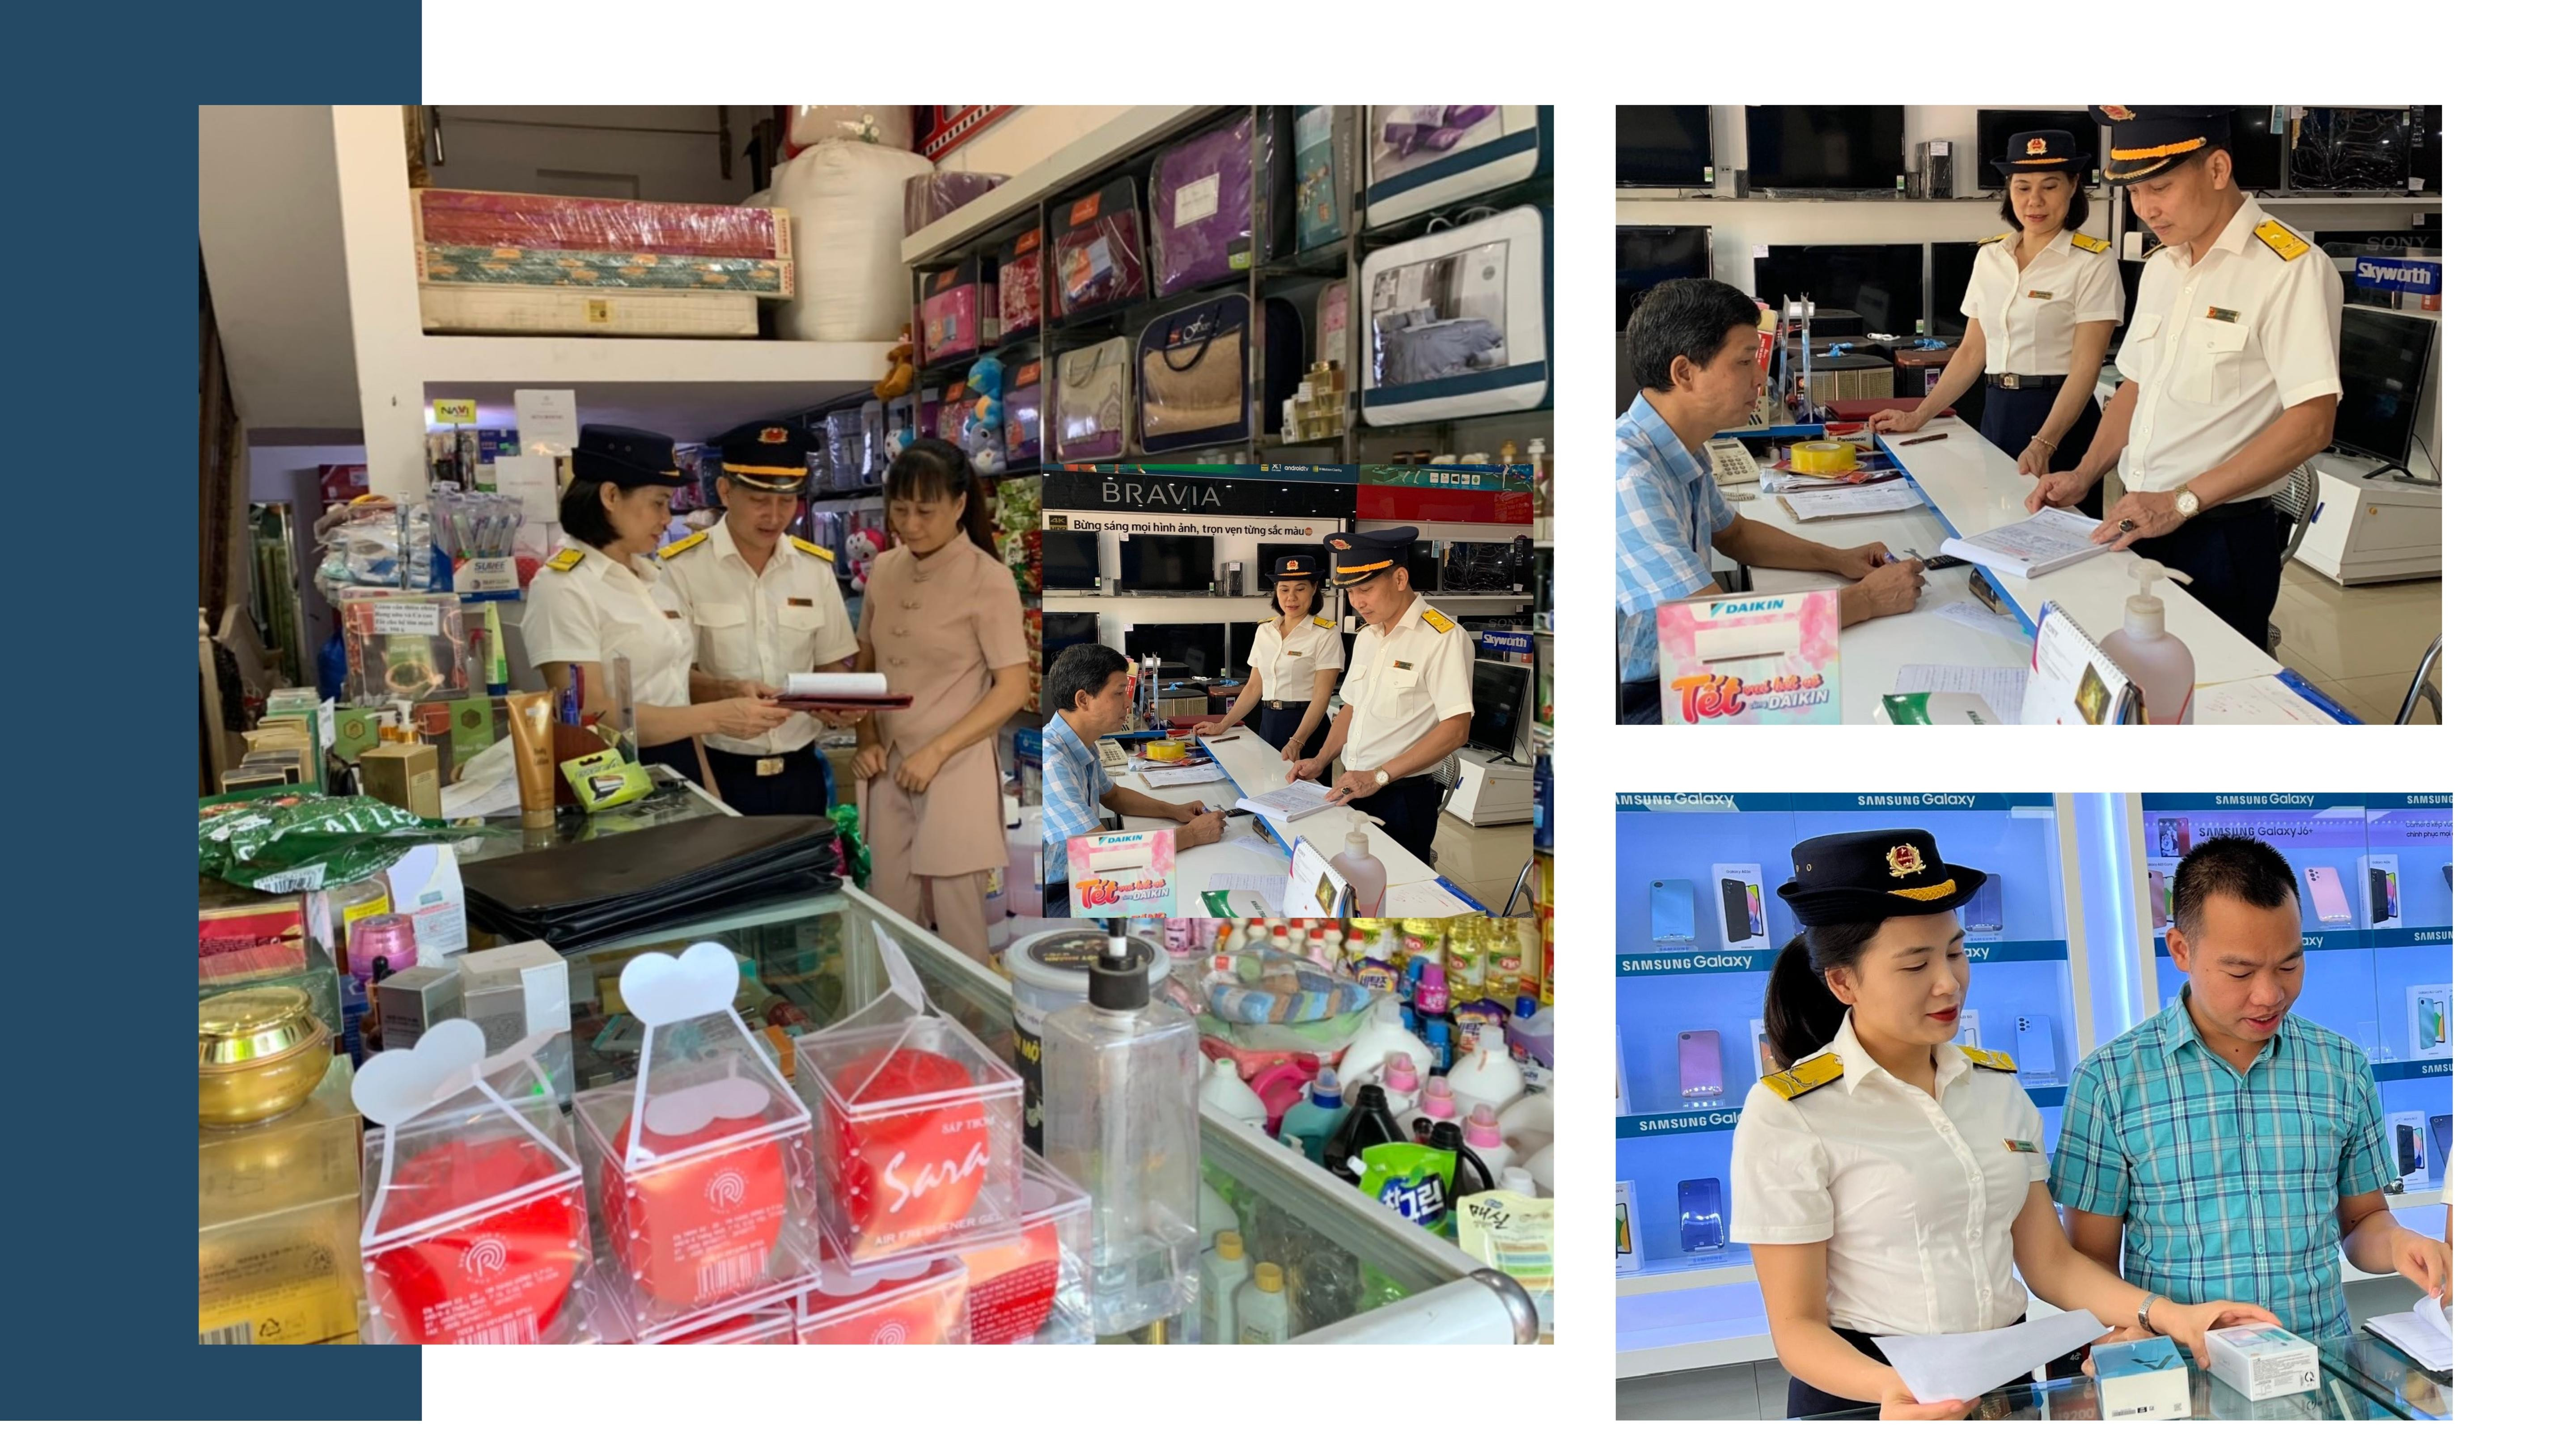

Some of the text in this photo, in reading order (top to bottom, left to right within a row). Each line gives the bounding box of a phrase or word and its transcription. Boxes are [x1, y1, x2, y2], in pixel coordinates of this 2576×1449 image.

[2366, 237, 2429, 250] SONY
[2358, 263, 2431, 284] Skyworth
[1102, 482, 1221, 507] BRAVIA
[1074, 519, 1101, 532] Bừng
[1104, 521, 1128, 533] sáng
[1132, 523, 1150, 534] mọi
[1153, 522, 1175, 533] hình
[1202, 524, 1223, 535] trọn
[1225, 526, 1242, 536] vẹn
[1245, 525, 1265, 536] từng
[1268, 524, 1282, 535] sắc
[1284, 526, 1304, 535] màu
[1725, 599, 1784, 614] DAIKIN
[1488, 619, 1526, 627] SONY
[1483, 634, 1526, 648] Skyworth
[1670, 674, 1746, 724] Tết
[1768, 689, 1830, 710] DAIKIN
[1674, 792, 1734, 808] Galaxy
[1858, 793, 1975, 808] SAMSUNG Galaxy
[2216, 793, 2314, 807] SAMSUNG Galaxy
[2407, 795, 2453, 804] SAMSUNG
[1108, 835, 1143, 843] DAIKIN
[2199, 826, 2313, 838] SAMSUNG Galaxy J6+
[2423, 831, 2439, 839] phục
[2440, 831, 2451, 839] mọi
[1075, 879, 1120, 909] Tết
[1132, 888, 1169, 901] DAIKIN
[2302, 936, 2323, 948] axy
[2415, 931, 2453, 941] SAMSUN
[1964, 947, 1989, 960] axy
[1623, 955, 1752, 971] SAMSUNG Galaxy
[2422, 1064, 2453, 1074] SAMSU
[1640, 1111, 1741, 1131] SAMSUNG Gal
[884, 1142, 990, 1213] Sara
[875, 1233, 895, 1246] AIR
[898, 1217, 975, 1239] FRESHENER
